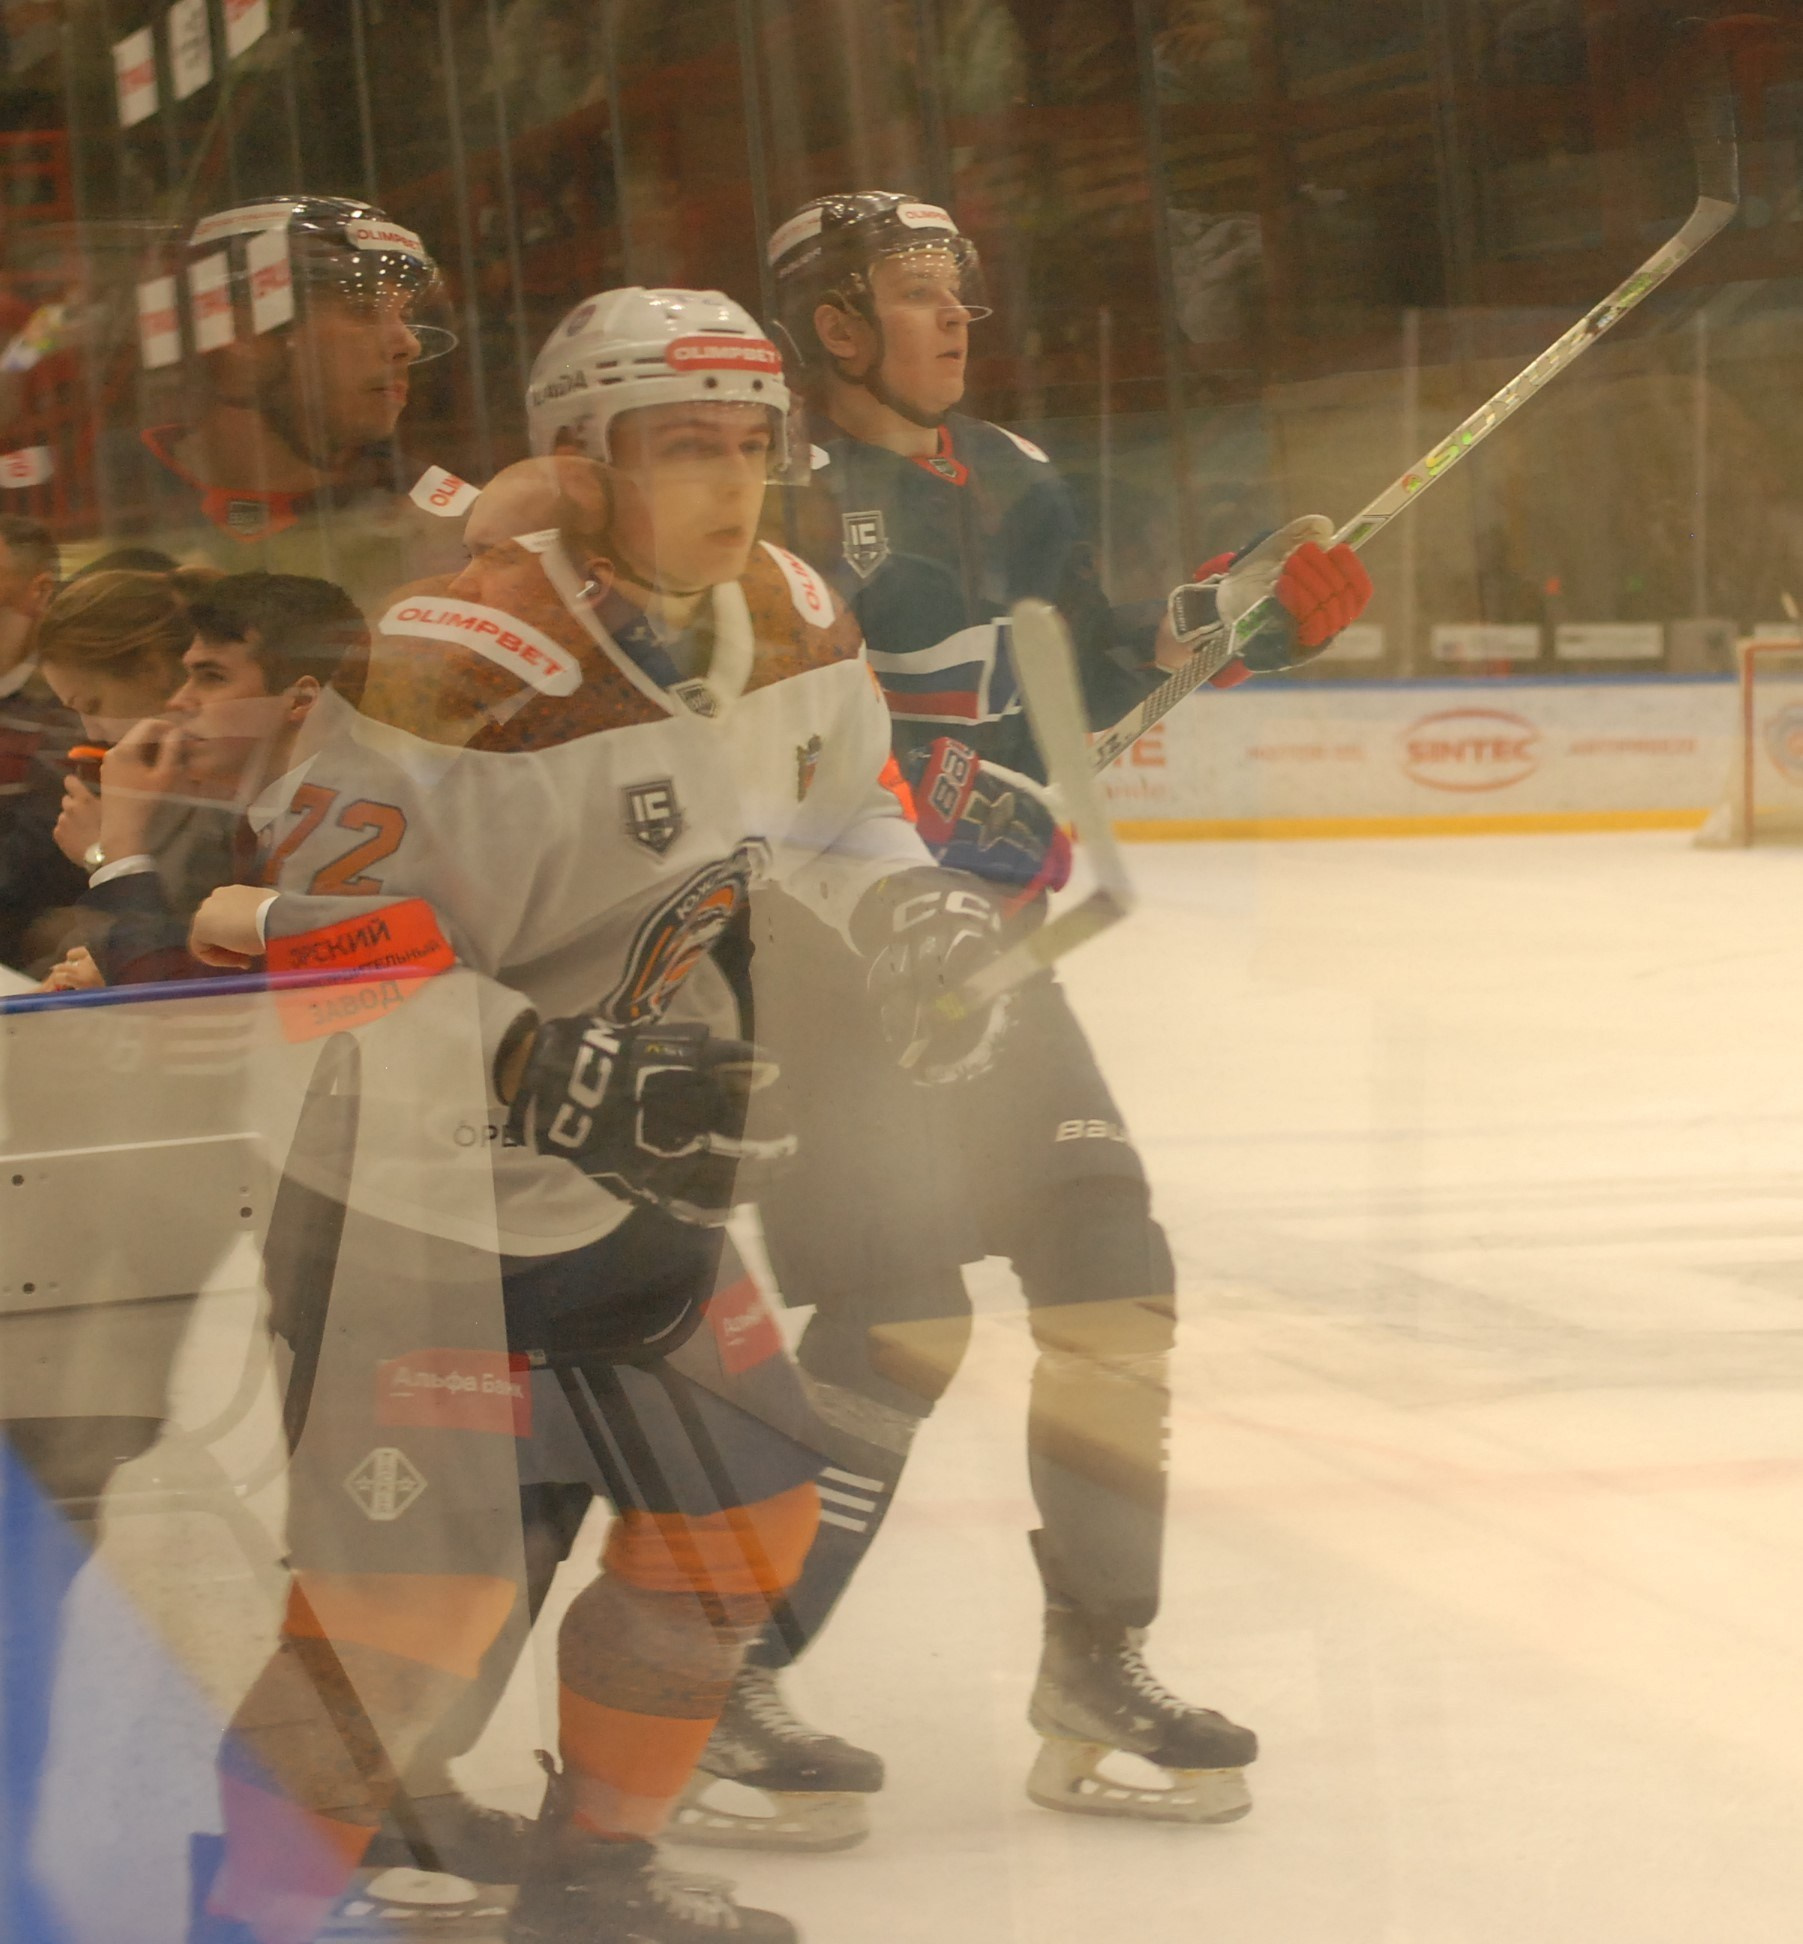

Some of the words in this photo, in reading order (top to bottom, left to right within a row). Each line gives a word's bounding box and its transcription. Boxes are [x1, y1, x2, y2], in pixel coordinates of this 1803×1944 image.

[673, 345, 777, 363] OLIMPBET
[396, 607, 566, 677] OLIMPBET
[1407, 738, 1533, 763] SINTEC
[262, 783, 407, 896] 72
[548, 1018, 620, 1148] CCM
[391, 1366, 478, 1394] Альфа
